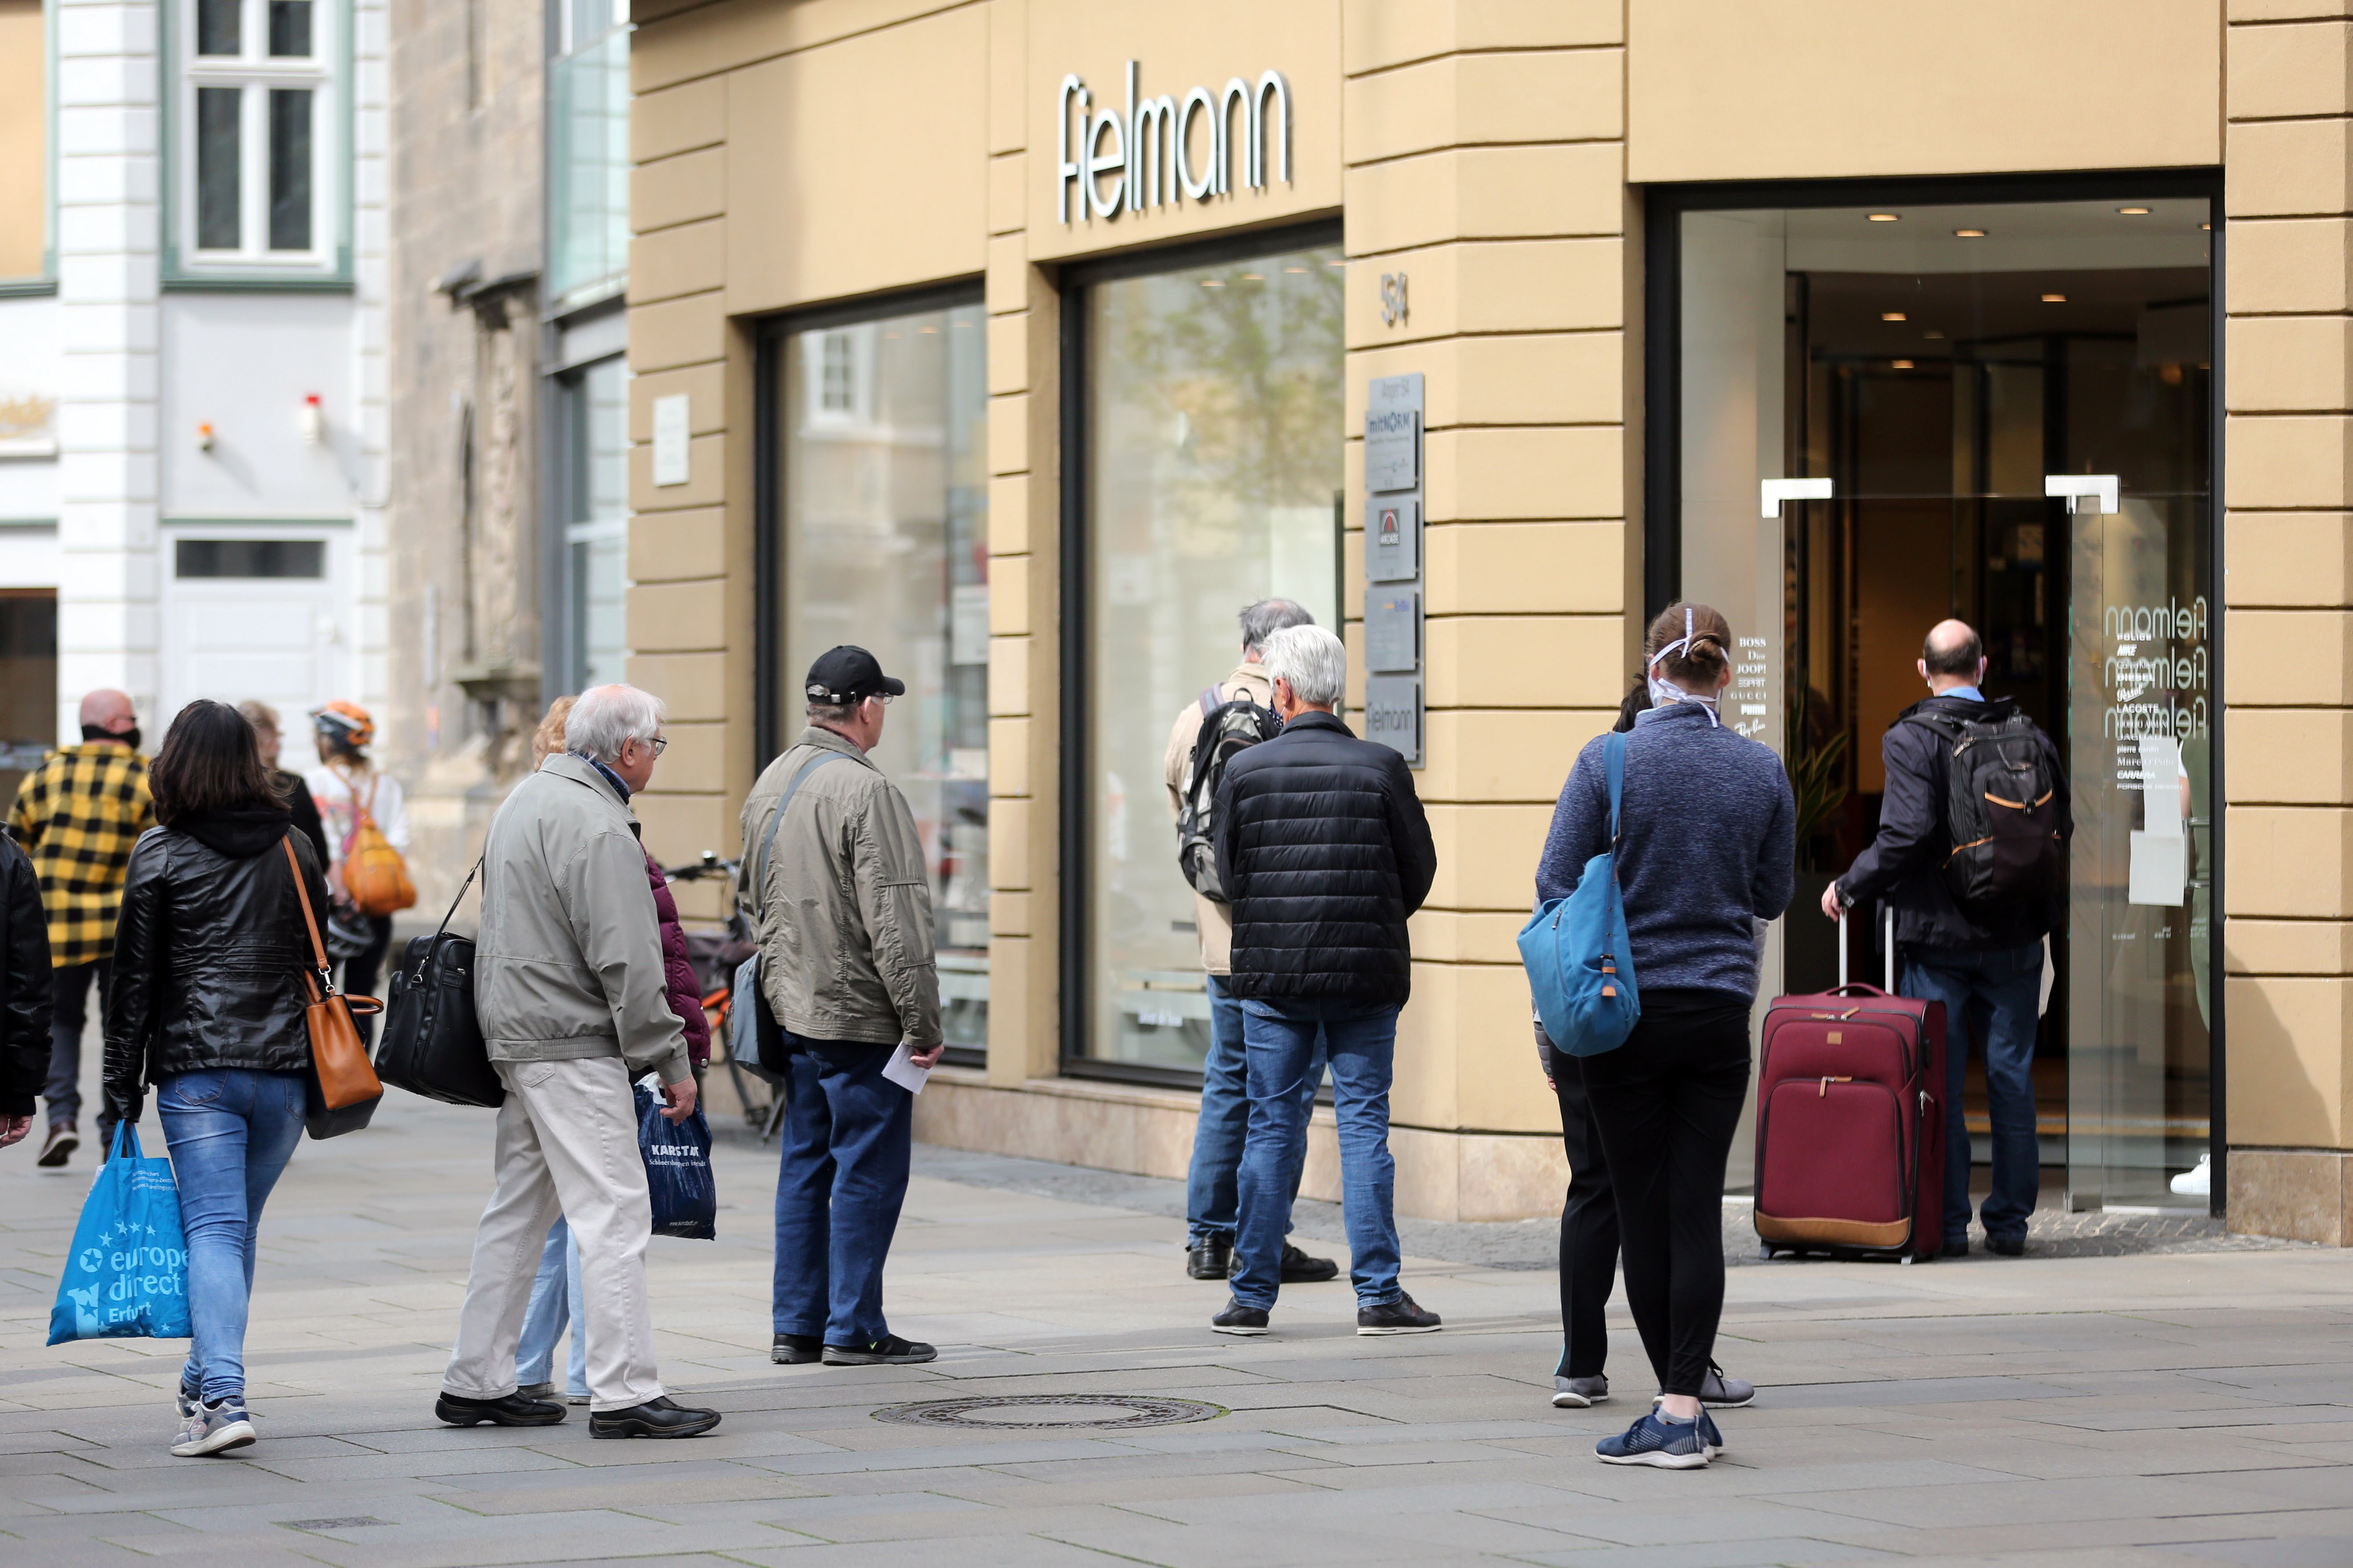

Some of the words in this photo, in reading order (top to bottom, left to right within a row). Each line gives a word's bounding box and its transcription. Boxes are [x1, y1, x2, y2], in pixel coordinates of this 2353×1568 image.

[1058, 60, 1288, 225] fielmann
[1381, 272, 1407, 325] 54
[1739, 636, 1767, 648] BOSS
[2117, 633, 2152, 641] POLICE
[1748, 649, 1766, 660] Dior
[2117, 644, 2137, 656] NIKE
[1736, 663, 1766, 674] JOOP!
[2117, 659, 2138, 669] Calvin
[2139, 659, 2156, 669] Klein
[1738, 677, 1766, 688] ESPRIT
[2117, 673, 2155, 682] DIESEL
[1730, 691, 1766, 700] GUCCI
[2117, 683, 2144, 702] Persol
[1740, 703, 1766, 715] PUMA
[2117, 703, 2159, 713] LACOSTE
[1733, 717, 1766, 738] Ray-Ban
[2117, 745, 2136, 755] pierre
[2138, 745, 2159, 754] cardin
[2117, 757, 2142, 766] Marc
[2117, 770, 2156, 779] CARRERA
[110, 1274, 183, 1301] direct
[109, 1301, 152, 1323] Erfurt
